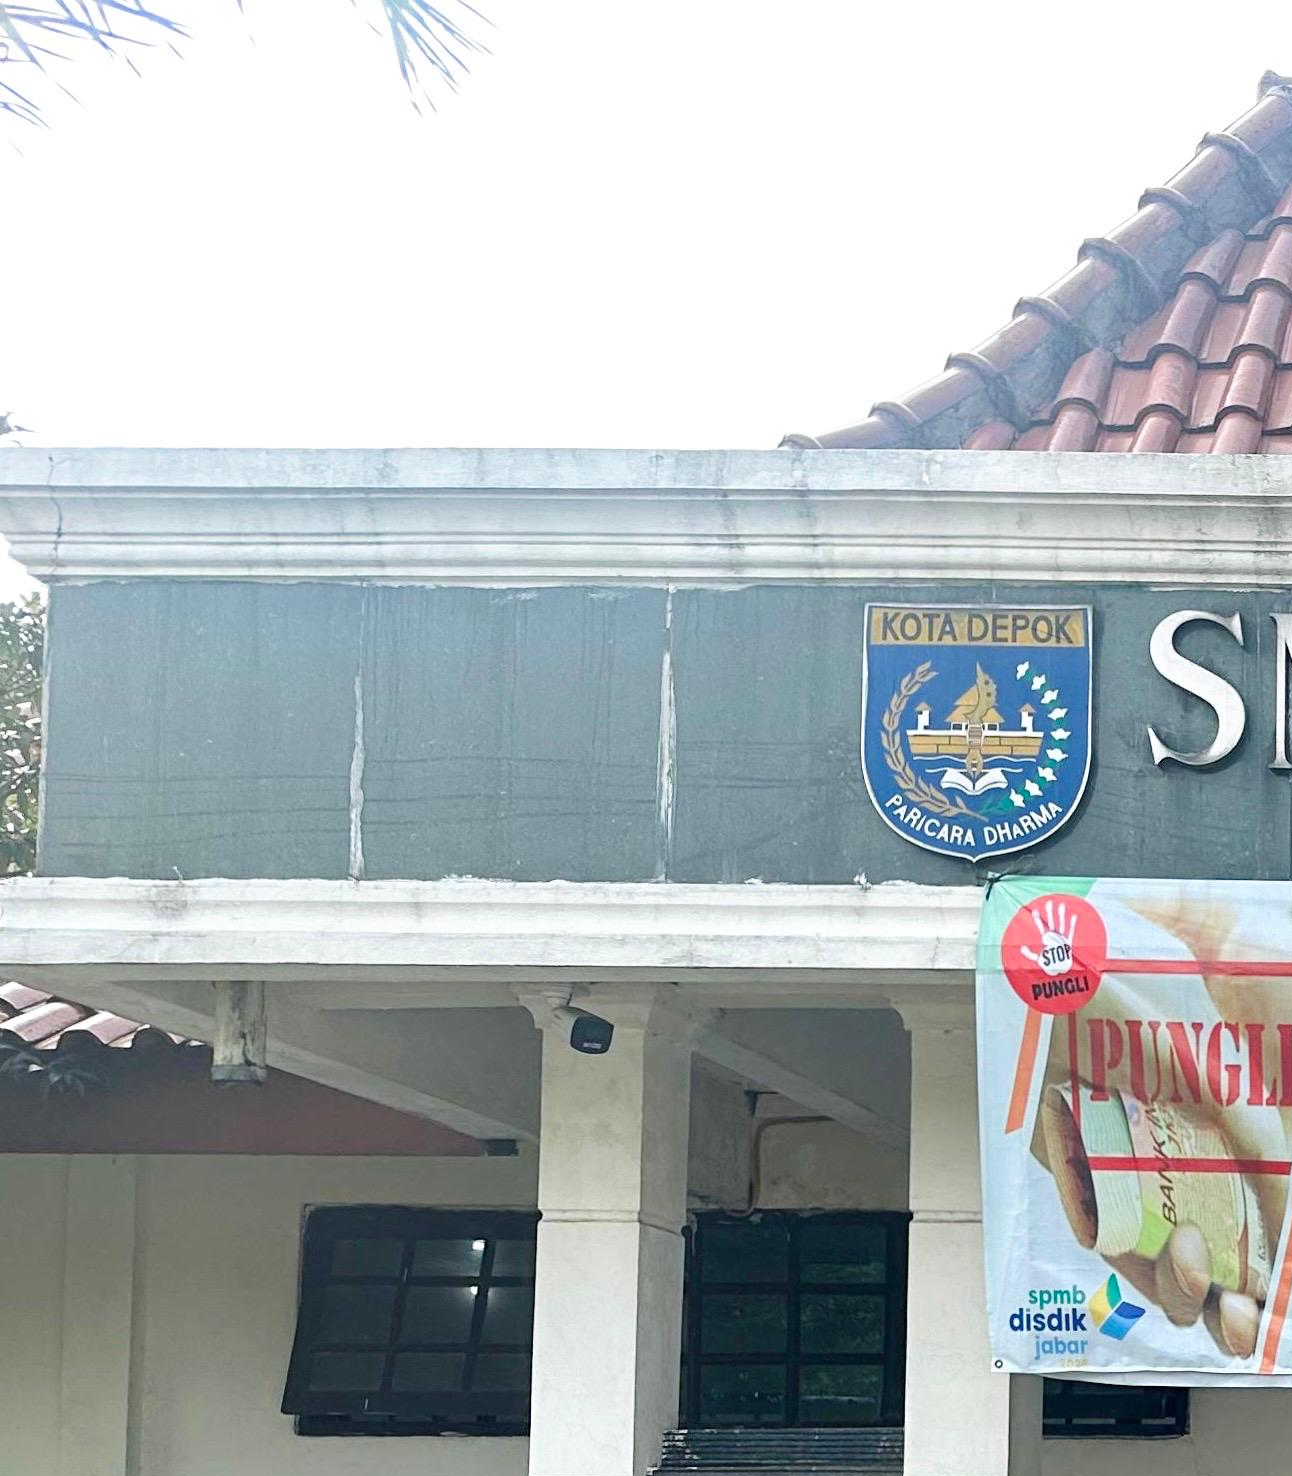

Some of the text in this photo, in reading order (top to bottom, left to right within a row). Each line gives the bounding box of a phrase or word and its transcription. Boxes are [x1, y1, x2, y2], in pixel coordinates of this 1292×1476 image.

[881, 612, 1073, 644] KOTA DEPOK
[885, 795, 1063, 846] PARICARA DHARMA
[1042, 944, 1071, 966] STOP
[1032, 976, 1089, 1000] PUNGLI
[1028, 1285, 1086, 1310] spmb
[1009, 1308, 1087, 1332] disdik
[1035, 1336, 1088, 1361] jabar
